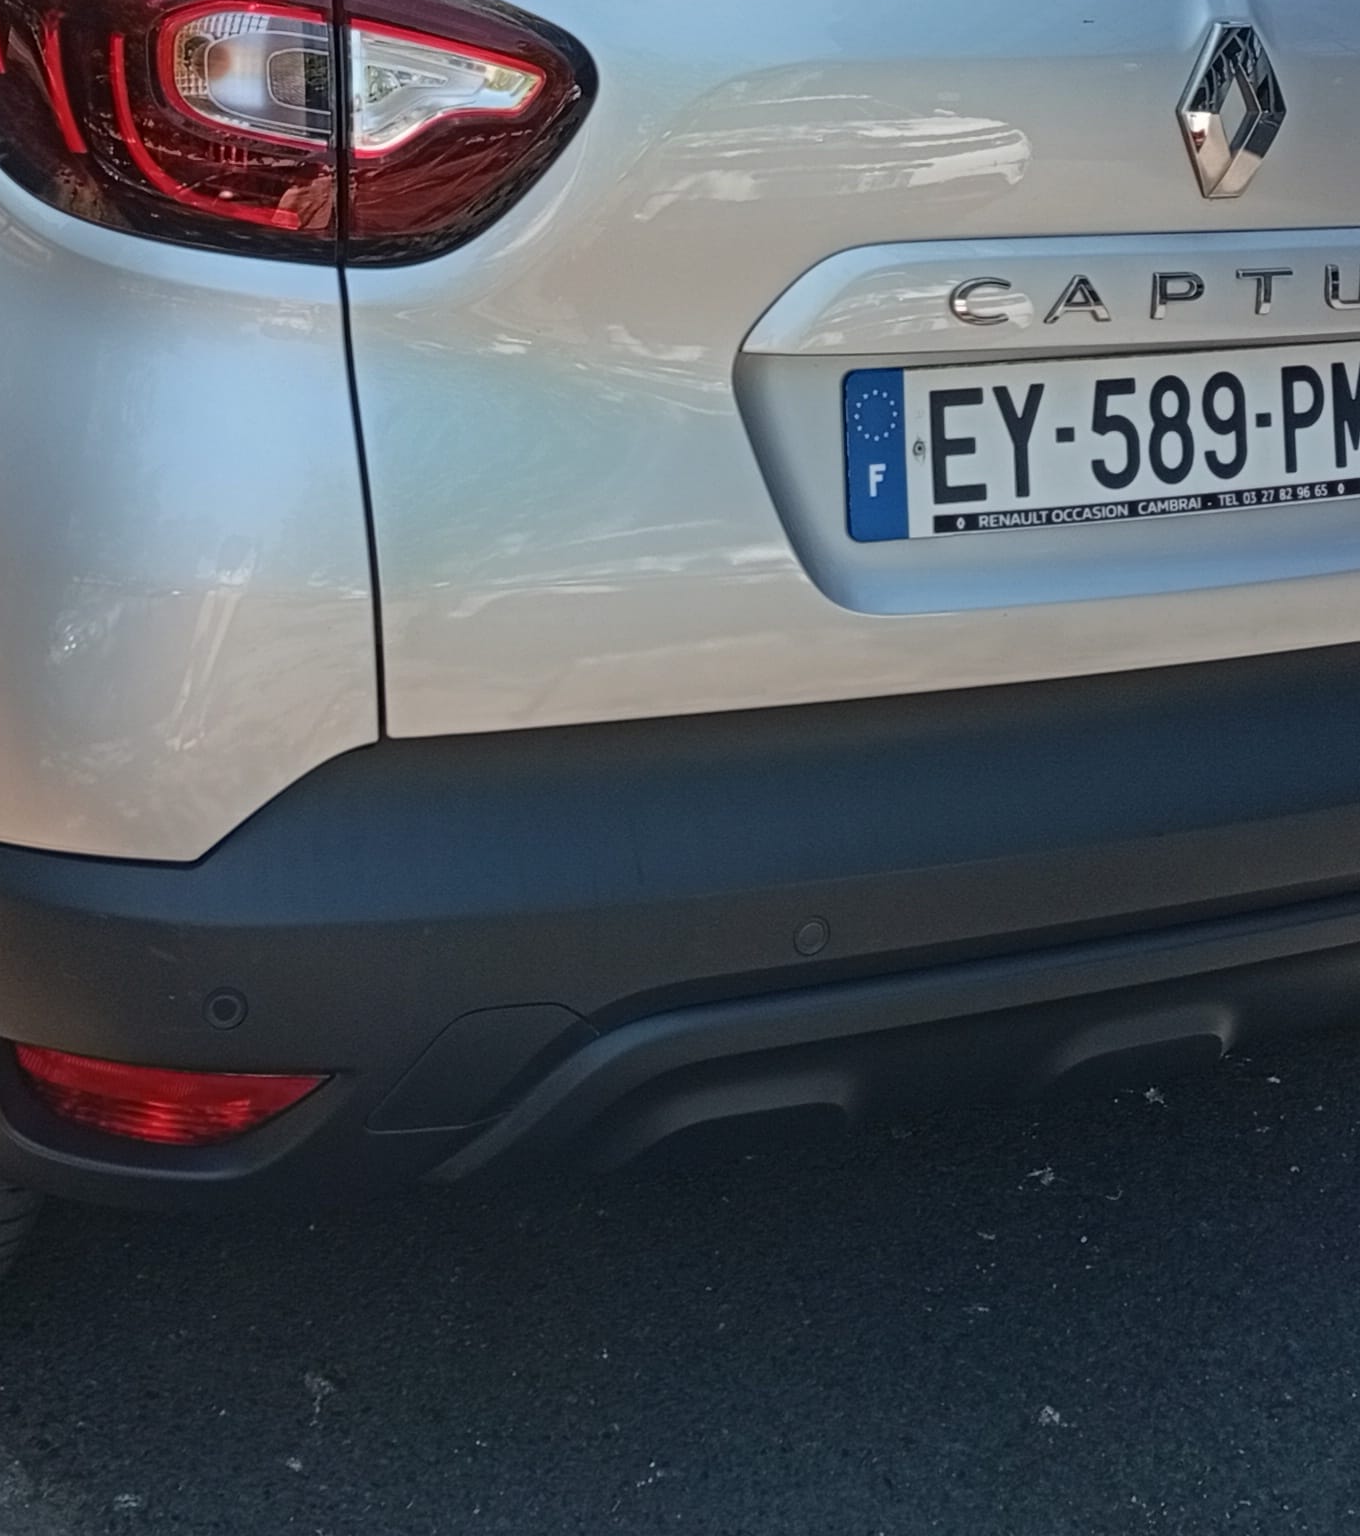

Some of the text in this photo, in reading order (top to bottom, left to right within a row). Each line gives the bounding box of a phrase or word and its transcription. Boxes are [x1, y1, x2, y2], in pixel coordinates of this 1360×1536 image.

[868, 464, 886, 498] F
[978, 510, 1048, 529] RENAULT
[1051, 503, 1129, 523] OCCASION
[1137, 497, 1202, 516] CAMBRAI
[1217, 494, 1240, 508] TEL
[1243, 491, 1257, 505] 03
[1262, 489, 1275, 503] 27
[1279, 487, 1293, 501] 82
[1296, 485, 1311, 499] 96
[1314, 483, 1328, 497] 65
